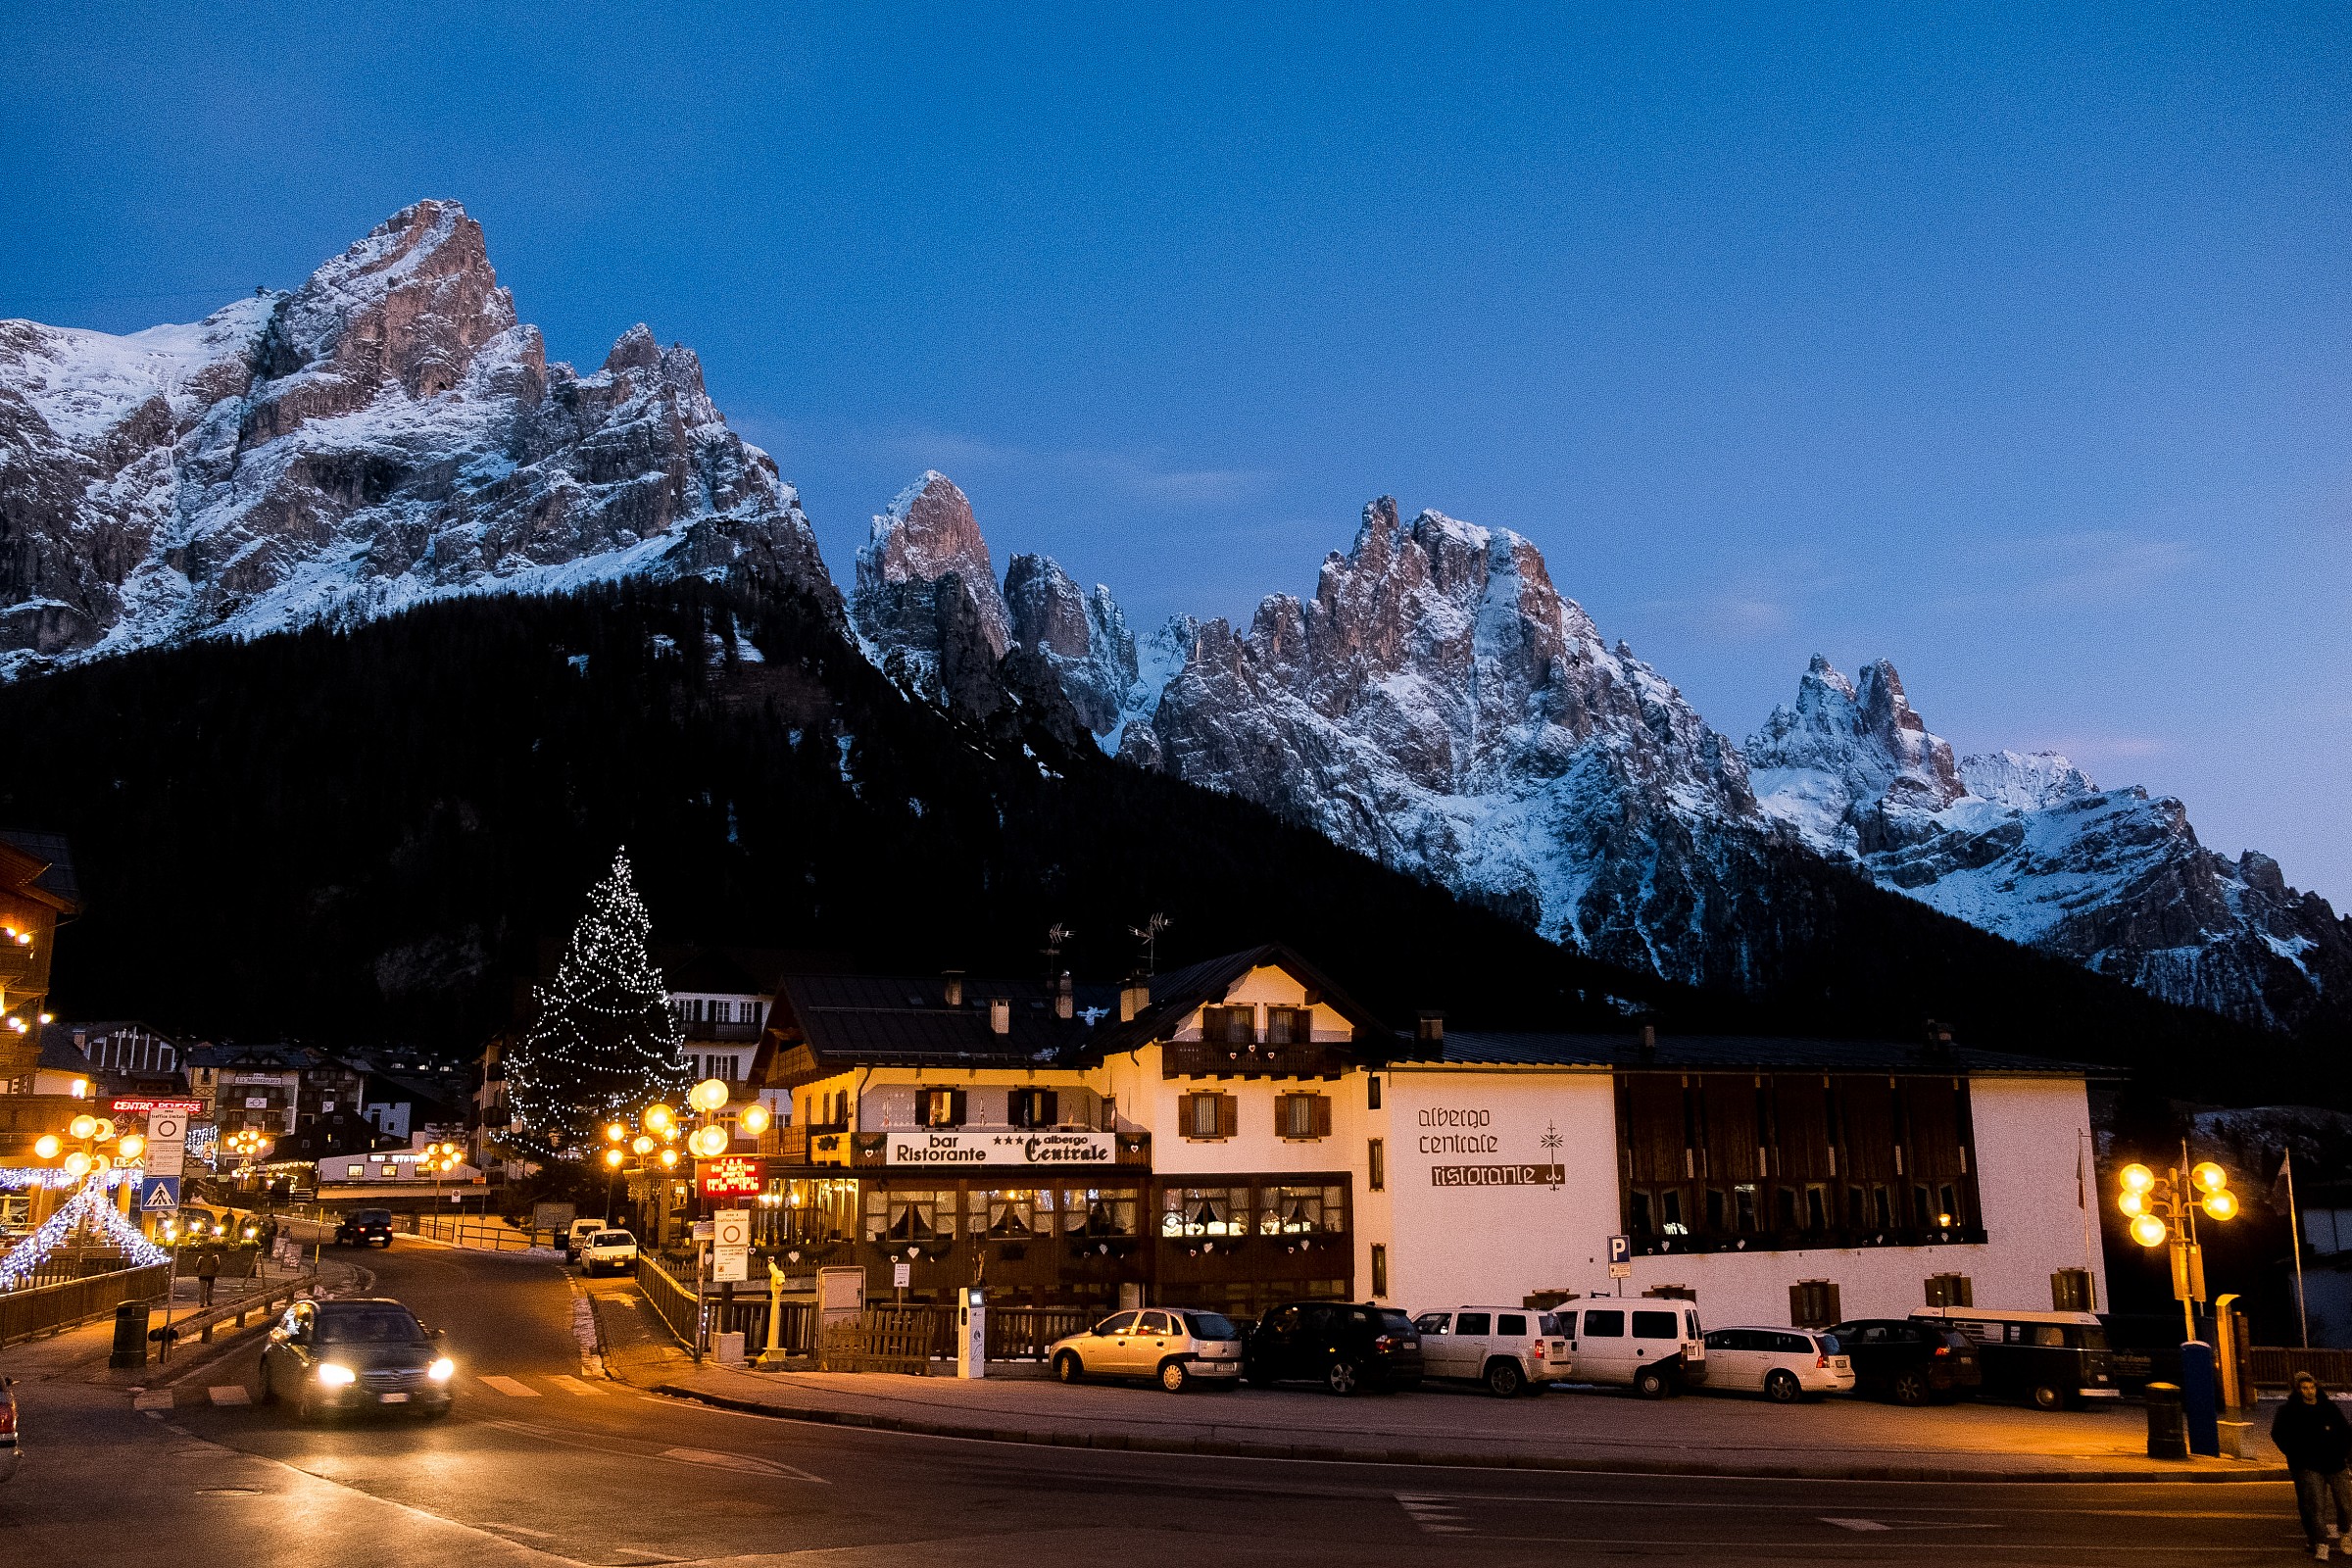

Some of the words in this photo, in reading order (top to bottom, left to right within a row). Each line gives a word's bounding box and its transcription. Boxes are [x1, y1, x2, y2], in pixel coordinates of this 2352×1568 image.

[1418, 1107, 1490, 1128] albergo
[929, 1134, 958, 1149] bar
[1024, 1134, 1108, 1162] Centrale
[1043, 1134, 1088, 1146] albergo
[1419, 1134, 1497, 1153] centrale
[897, 1145, 987, 1162] Ristorante
[710, 1164, 724, 1173] San
[726, 1163, 756, 1172] Martino
[1434, 1166, 1536, 1185] ristorante
[1612, 1238, 1626, 1261] P
